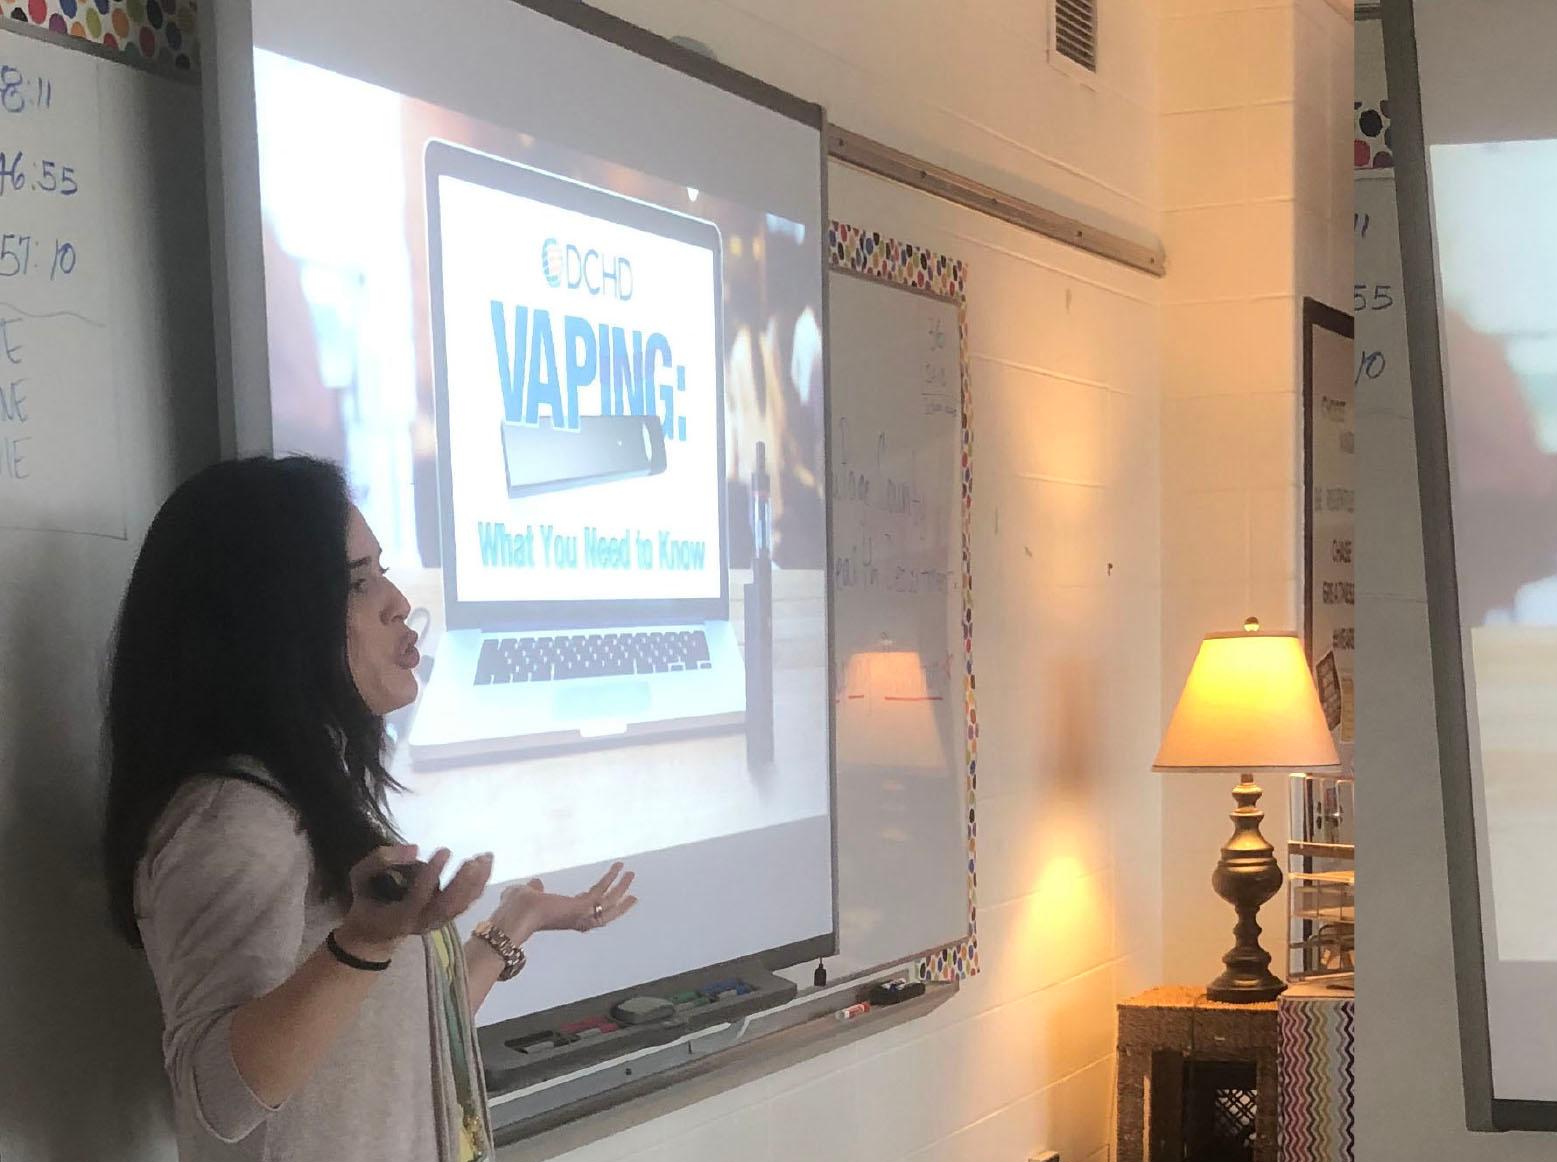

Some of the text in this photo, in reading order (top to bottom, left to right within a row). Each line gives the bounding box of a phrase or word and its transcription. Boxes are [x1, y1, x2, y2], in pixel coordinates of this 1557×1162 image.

[566, 243, 634, 301] DCHD
[490, 300, 688, 441] VAPING:
[477, 521, 706, 571] What You Need to Know
